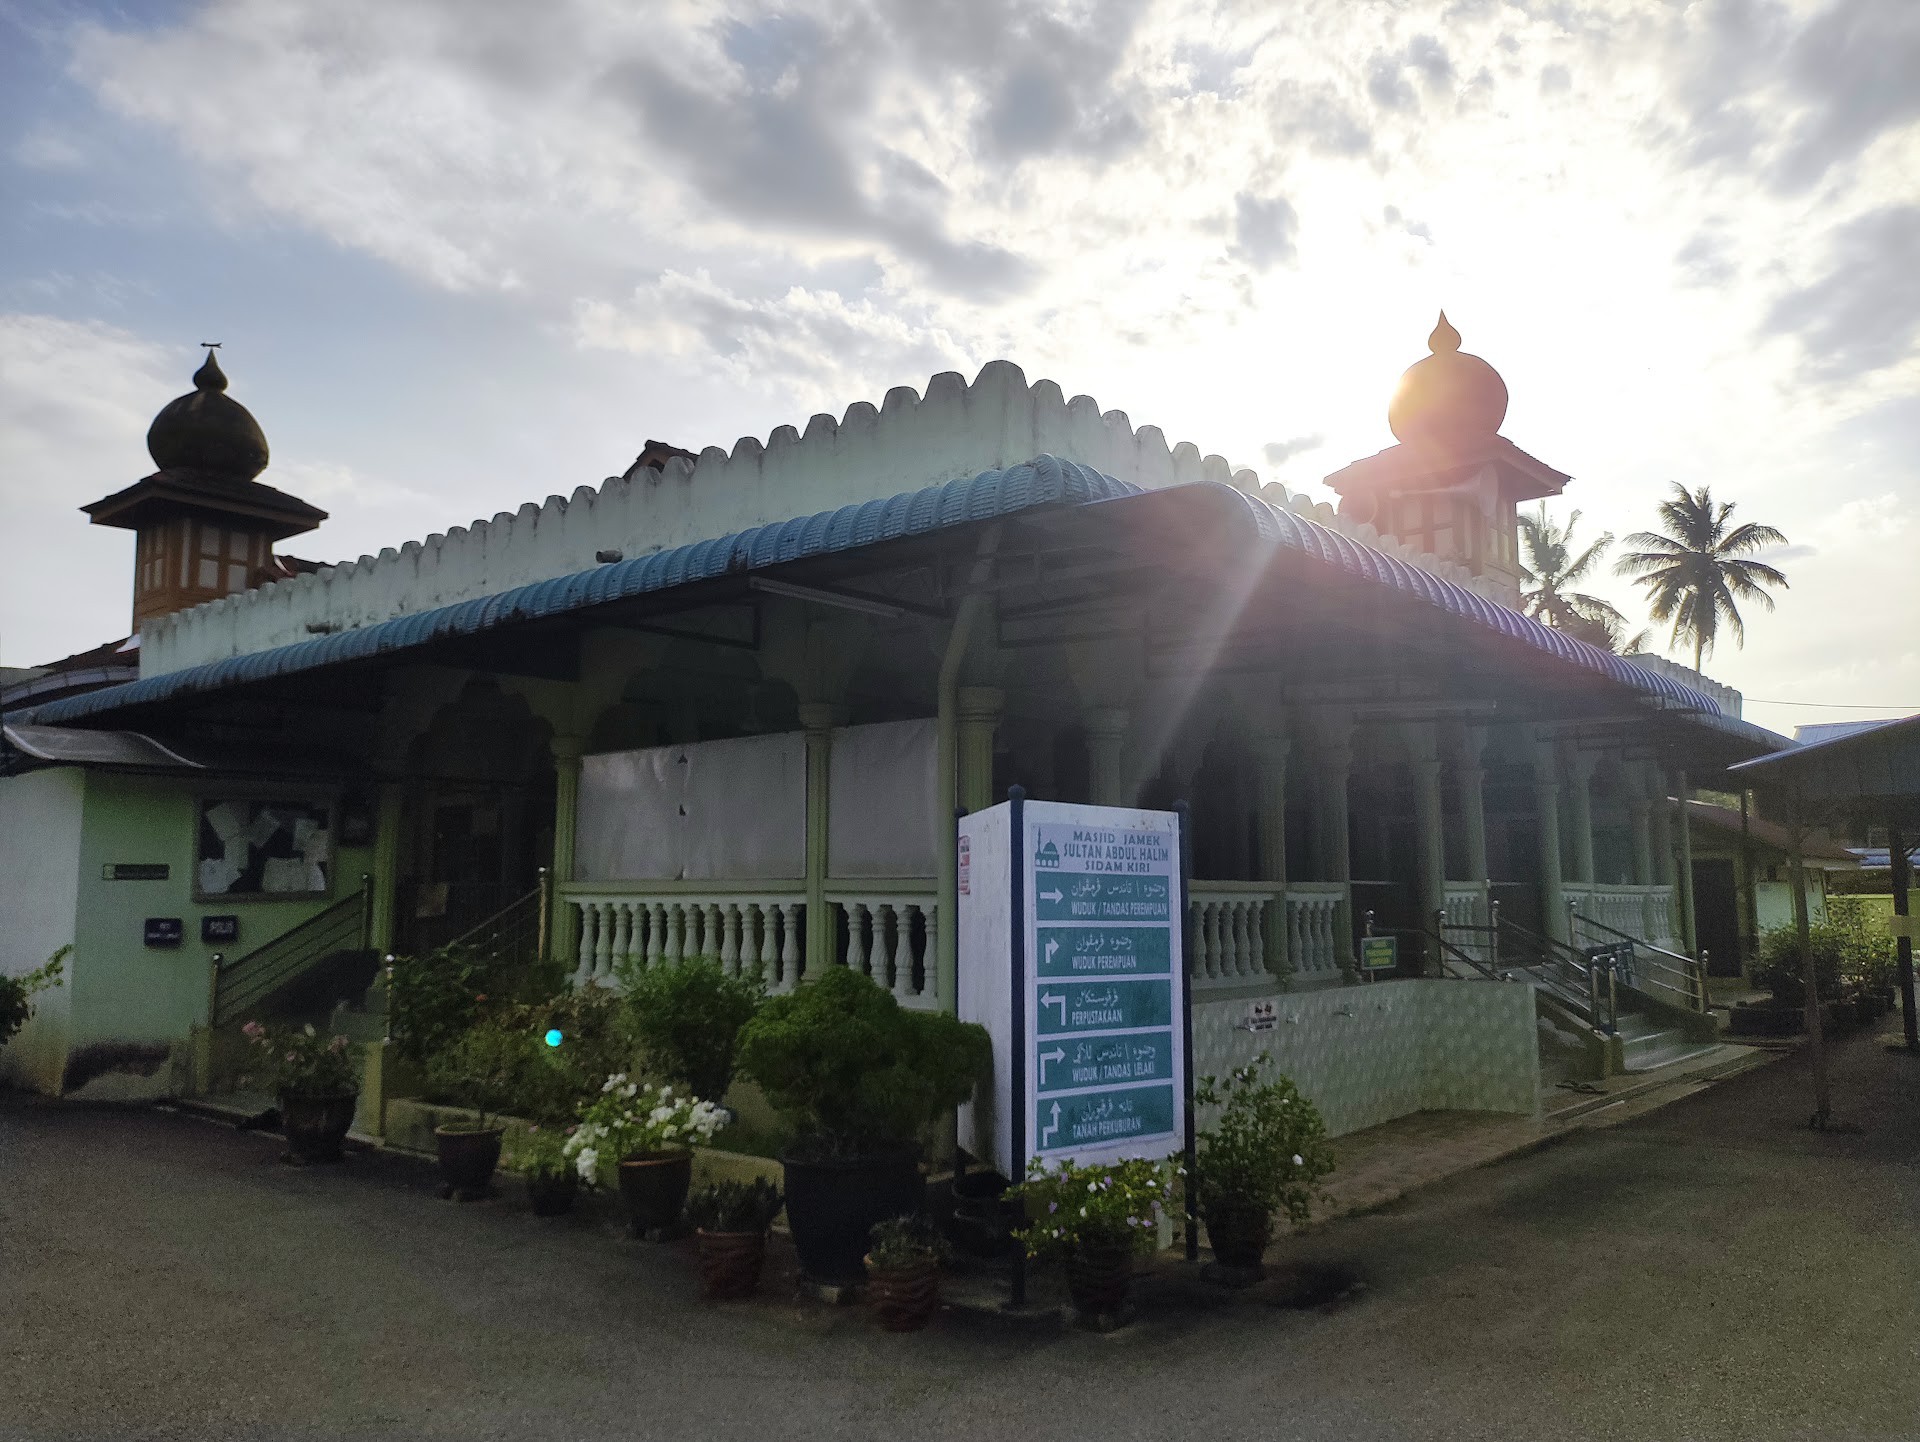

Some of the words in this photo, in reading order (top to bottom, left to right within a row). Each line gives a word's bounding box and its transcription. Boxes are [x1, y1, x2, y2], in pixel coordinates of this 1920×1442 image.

[1073, 830, 1115, 844] MASJID
[1123, 833, 1160, 846] JAMEK
[1063, 843, 1102, 859] SULTAN
[1105, 845, 1137, 860] ABDUL
[1139, 847, 1169, 861] HALIM
[1085, 859, 1123, 872] SIDAM
[1127, 862, 1150, 873] KIRI
[1071, 901, 1096, 915] WUDUK
[1102, 901, 1129, 916] TANDAS
[1129, 902, 1168, 916] PEREMPUAN
[1071, 955, 1096, 970] WUDUK
[1097, 954, 1137, 969] PEREMPUAN
[1071, 1008, 1123, 1025] PERPUSTAKAAN
[1072, 1066, 1098, 1082] WUDUK
[1103, 1062, 1131, 1079] TANDAS
[1133, 1060, 1155, 1076] LELAKI
[1073, 1121, 1098, 1139] TANAH
[1098, 1115, 1142, 1136] PERKUBURAN
